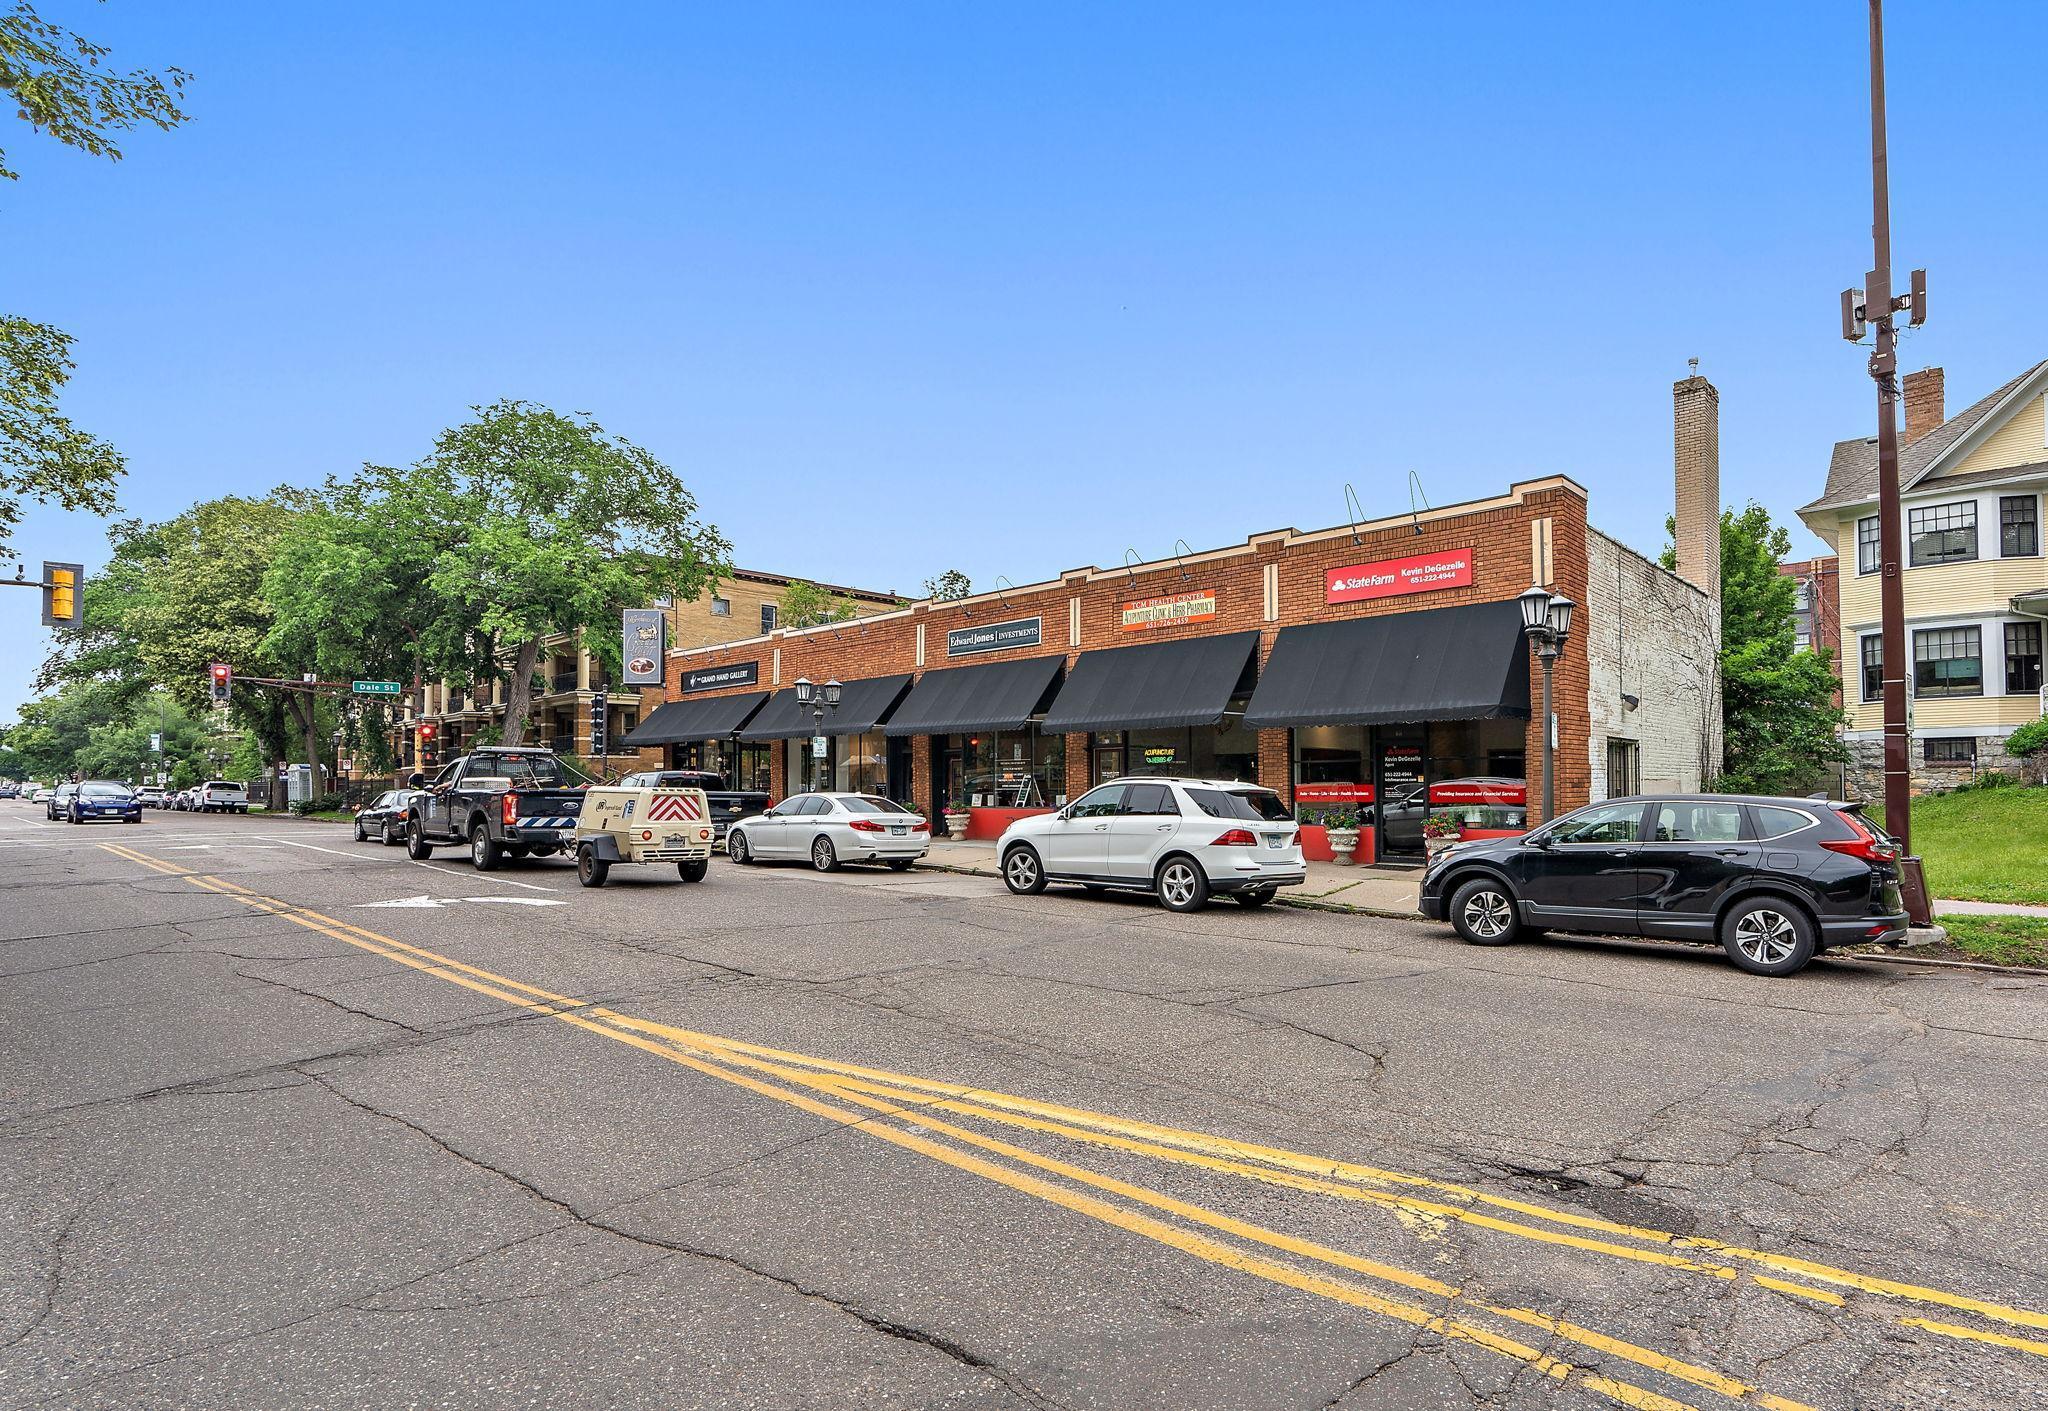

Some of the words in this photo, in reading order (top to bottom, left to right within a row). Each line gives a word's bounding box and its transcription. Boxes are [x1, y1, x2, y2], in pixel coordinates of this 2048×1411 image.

[1401, 568, 1422, 577] Kevin
[1424, 561, 1466, 574] DeGezelle
[1410, 572, 1456, 584] 651-222-4944
[1131, 601, 1147, 609] TCM
[1149, 597, 1175, 607] HEALTH
[1177, 592, 1205, 602] CENTER
[1172, 604, 1186, 618] HERB
[1186, 601, 1214, 616] PHARMACY
[1145, 617, 1189, 629] 651-726-2459
[998, 627, 1038, 640] INVESTMENTS
[729, 670, 748, 679] GALLERY
